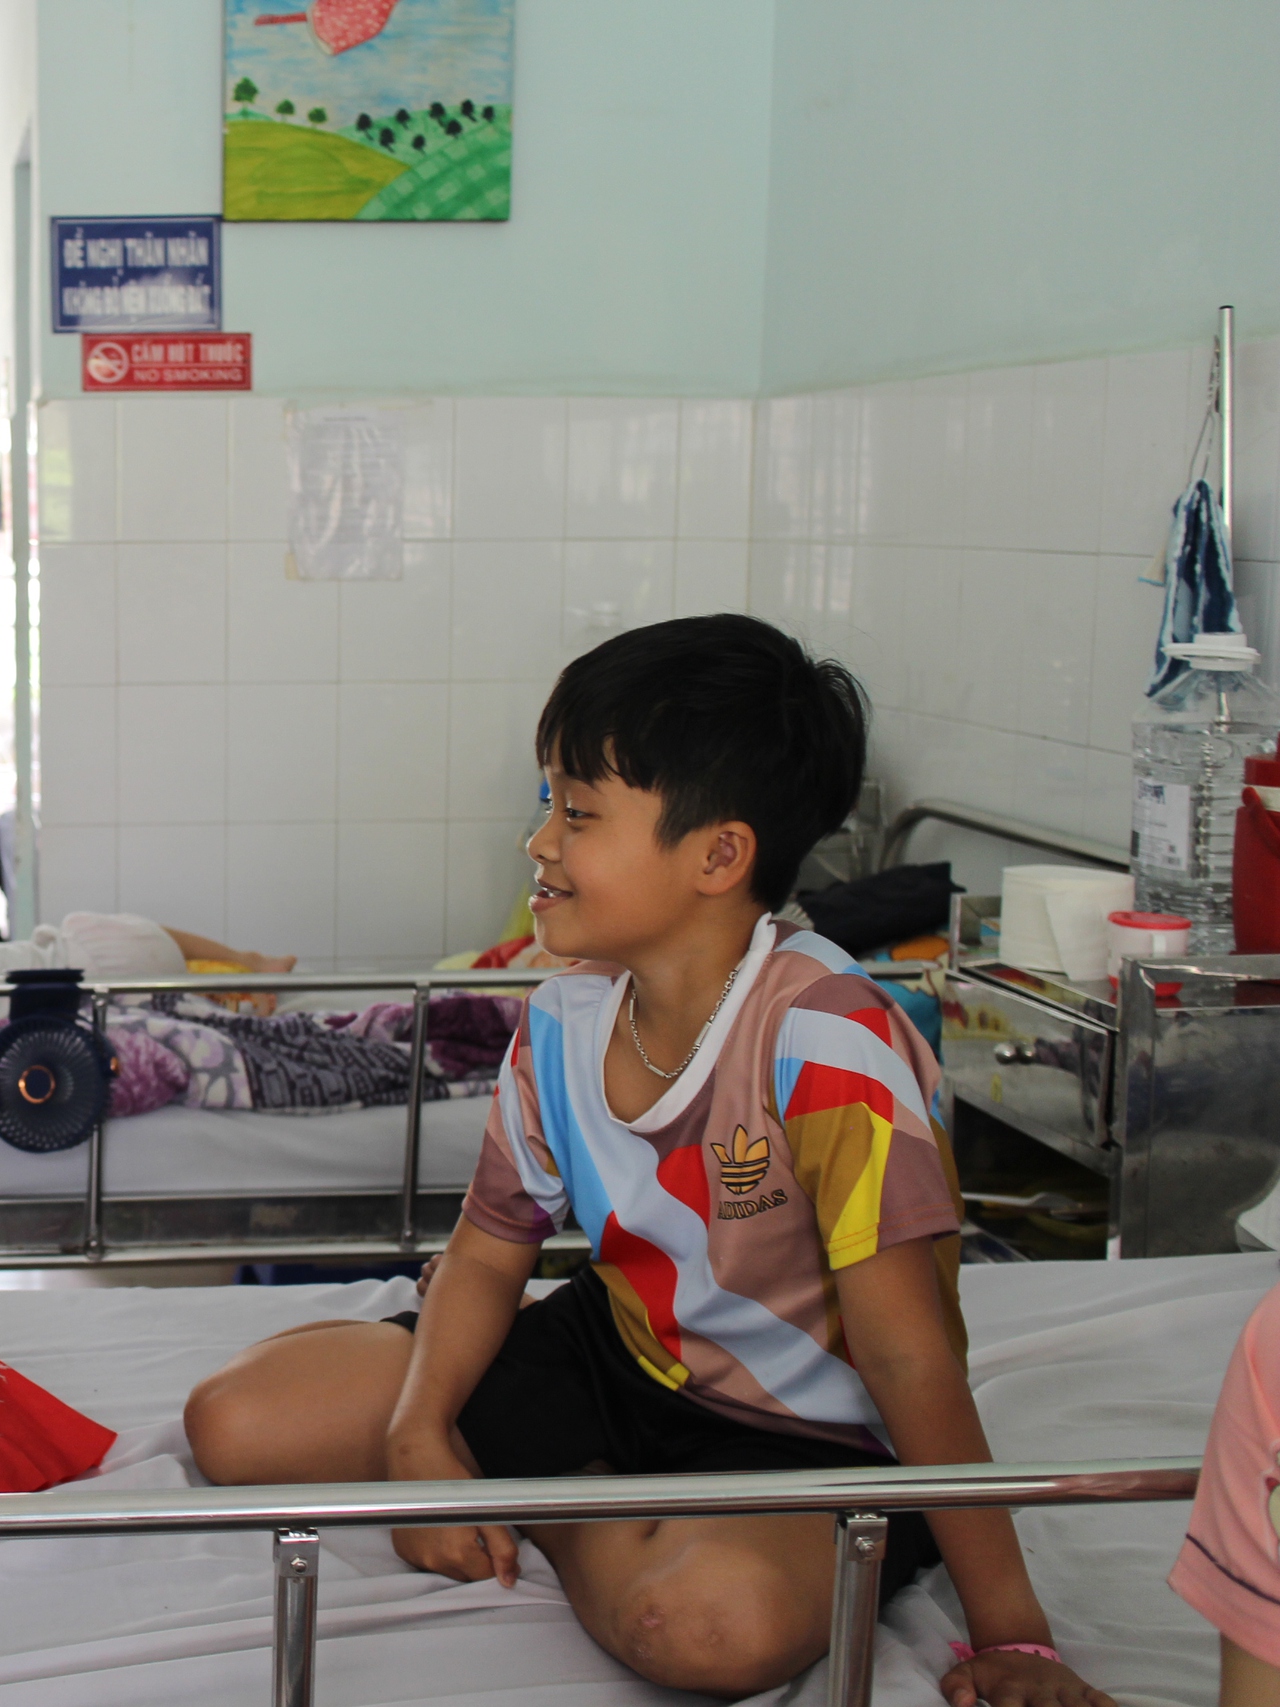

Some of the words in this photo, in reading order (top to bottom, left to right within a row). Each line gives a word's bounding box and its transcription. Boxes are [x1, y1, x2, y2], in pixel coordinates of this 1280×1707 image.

[133, 369, 160, 382] NO
[163, 368, 243, 382] SMOKING
[718, 1188, 788, 1220] ADIDAS
